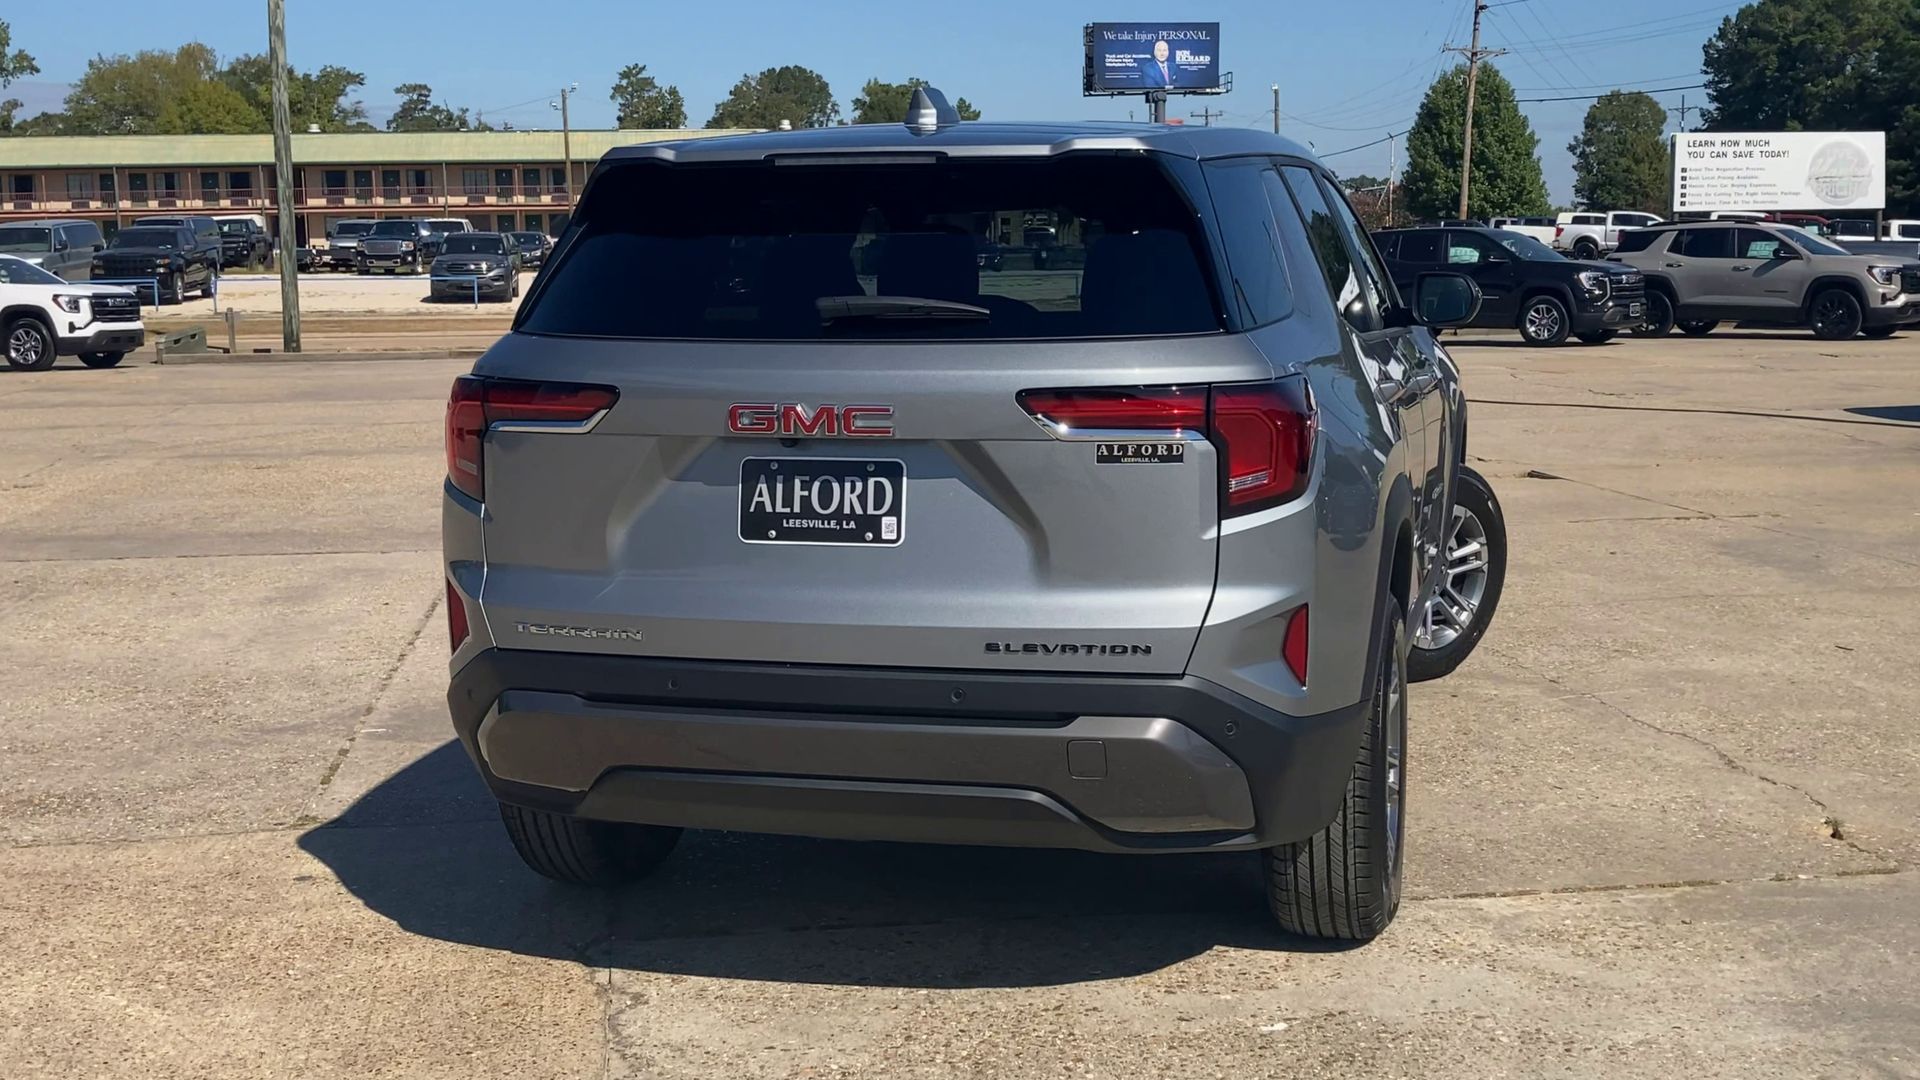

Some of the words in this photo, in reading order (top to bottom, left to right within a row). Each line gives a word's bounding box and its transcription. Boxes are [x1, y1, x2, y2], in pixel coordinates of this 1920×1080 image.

[1104, 31, 1117, 40] We
[1118, 31, 1134, 40] take
[1135, 30, 1158, 42] Injury
[1158, 30, 1210, 40] PERSONAL.
[728, 402, 894, 436] GMC
[1098, 444, 1183, 456] ALFORD
[750, 474, 894, 515] ALFORD
[783, 518, 840, 530] LEESVILLE,
[842, 520, 856, 529] LA
[514, 621, 643, 641] TERRAIN
[984, 641, 1152, 656] ELEVATION
